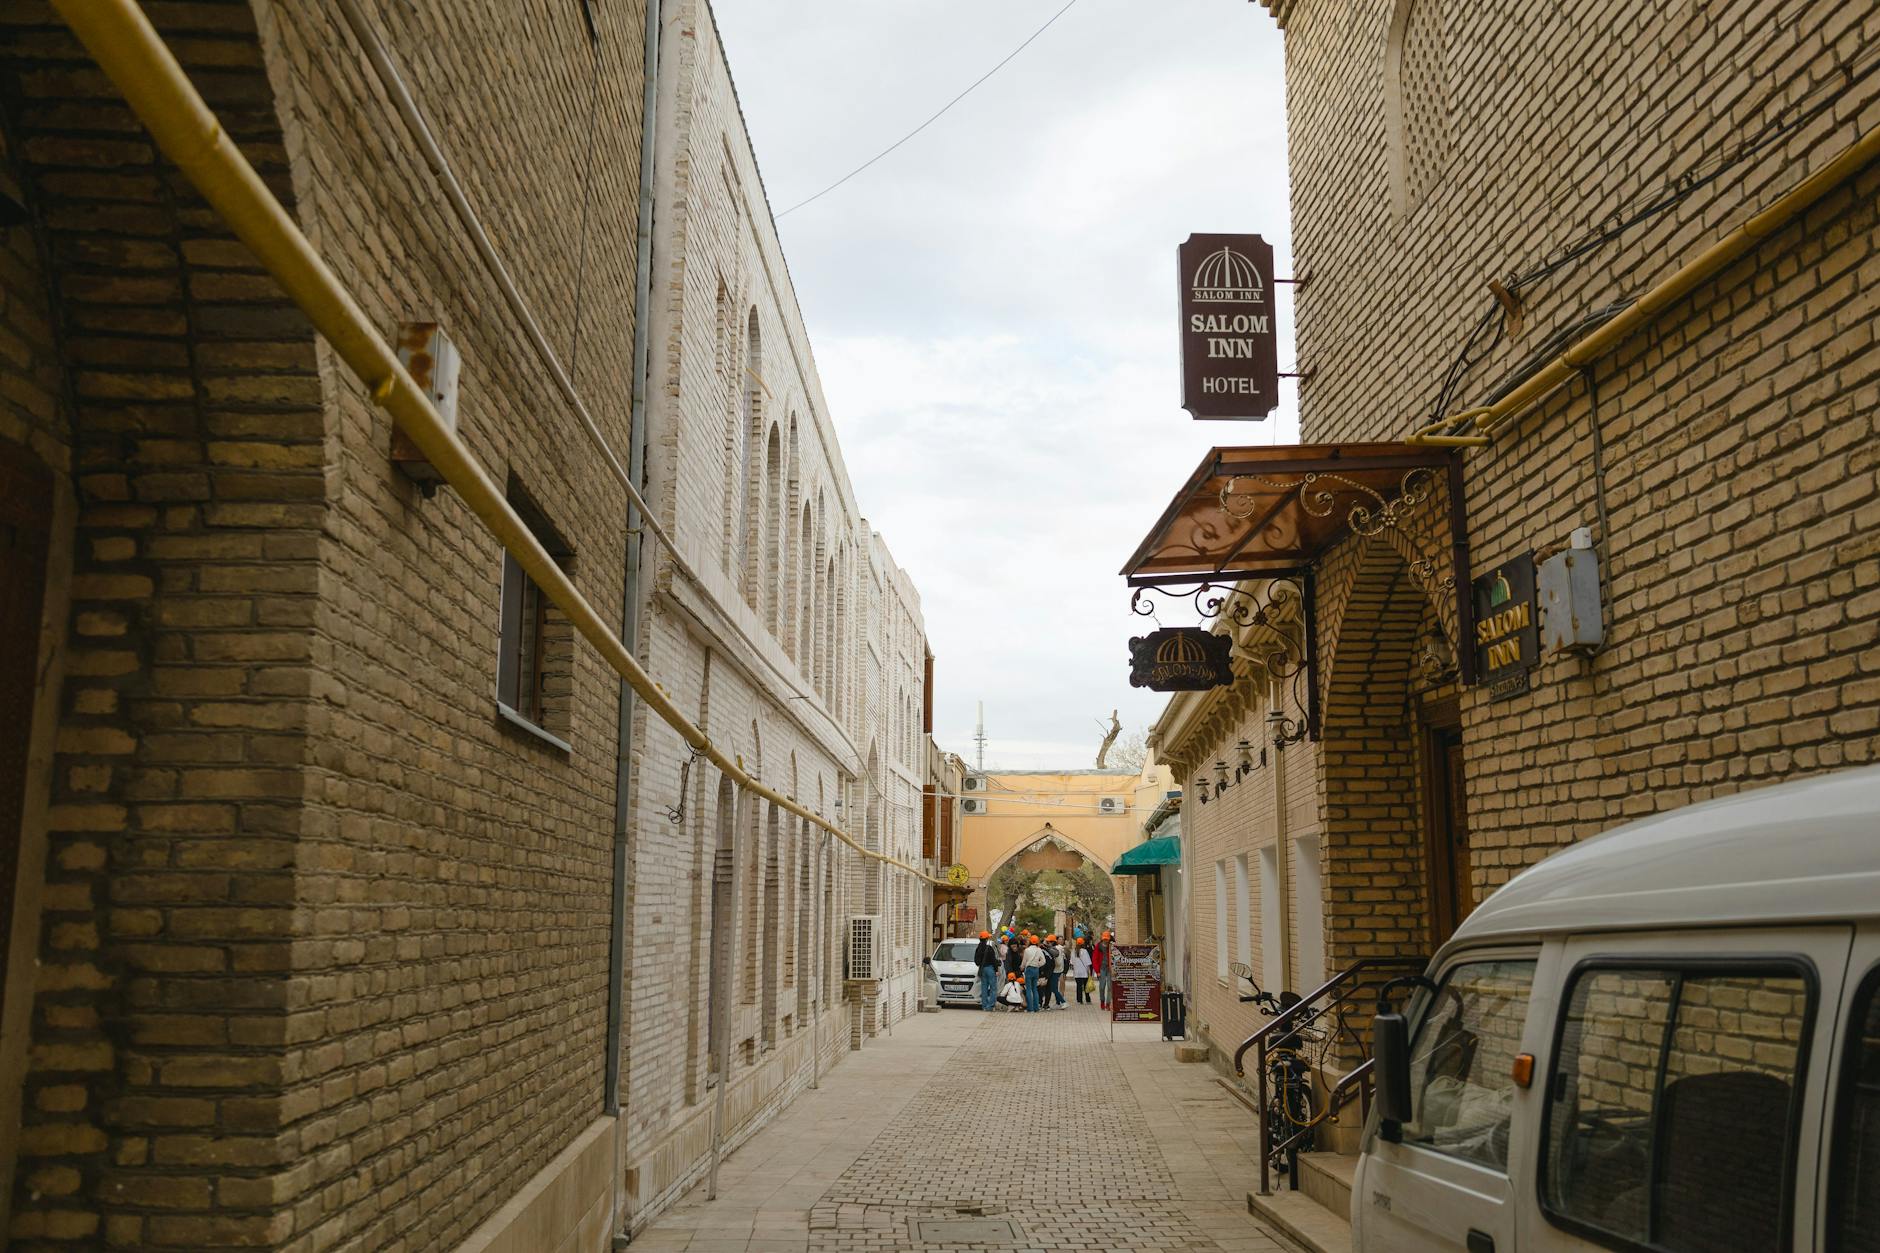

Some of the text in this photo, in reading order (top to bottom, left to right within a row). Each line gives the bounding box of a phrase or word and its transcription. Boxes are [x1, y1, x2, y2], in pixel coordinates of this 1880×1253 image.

[1194, 290, 1261, 300] SALOM INN
[1190, 314, 1269, 333] SALOM
[1207, 338, 1254, 358] INN
[1202, 376, 1260, 394] HOTEL
[1476, 601, 1531, 645] SALOM
[1487, 637, 1521, 671] INN
